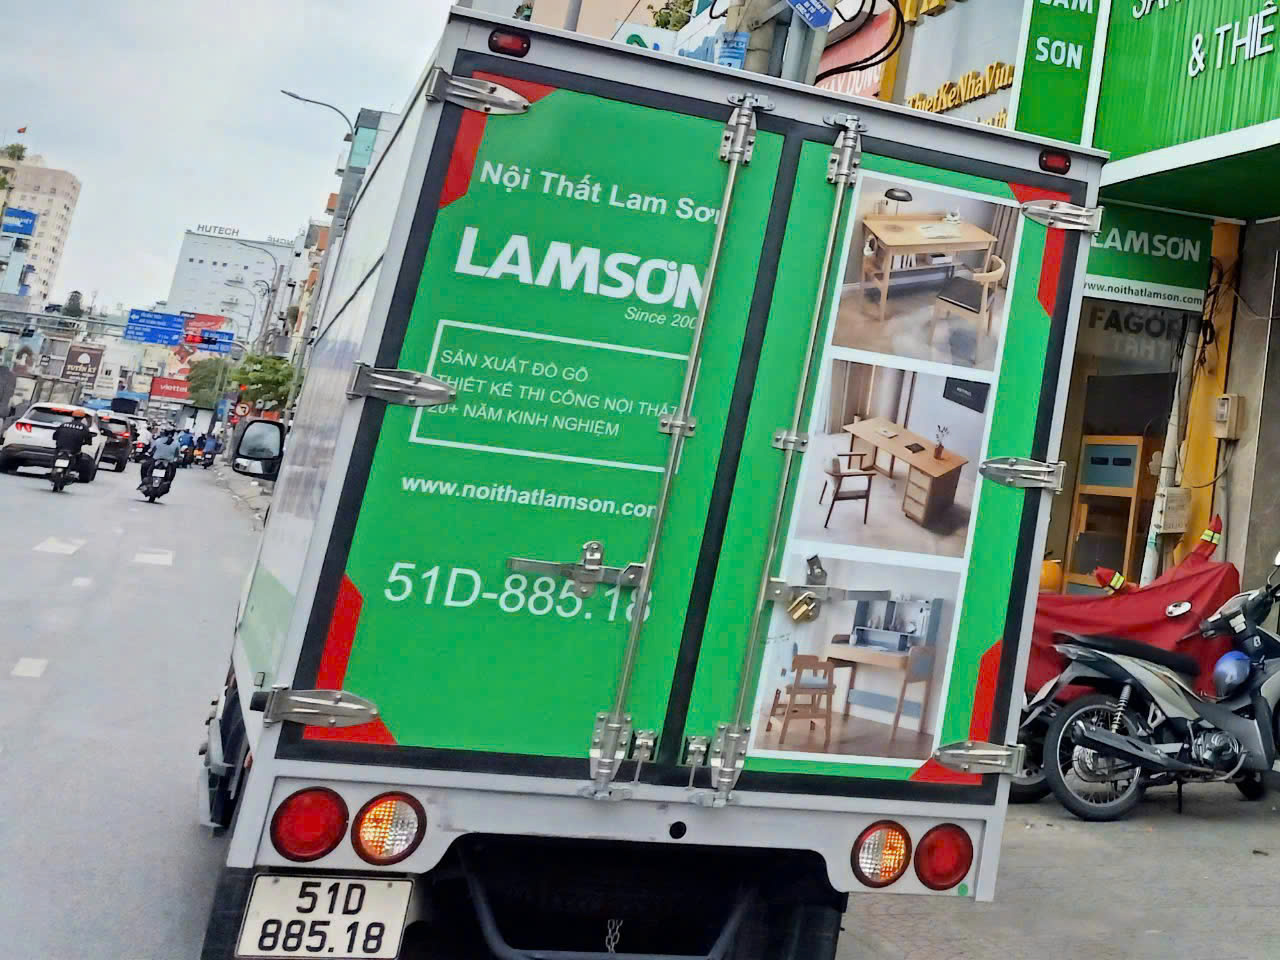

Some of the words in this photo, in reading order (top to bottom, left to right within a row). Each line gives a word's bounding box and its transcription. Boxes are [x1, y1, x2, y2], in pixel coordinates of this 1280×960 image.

[1187, 33, 1206, 77] &
[479, 161, 531, 192] Nội
[540, 170, 602, 203] Thất
[609, 184, 667, 214] Lam
[197, 223, 240, 237] HUTECH
[624, 306, 667, 325] Since
[440, 348, 478, 367] SẢN
[160, 383, 188, 393] viettel
[519, 385, 545, 402] THI
[549, 388, 600, 409] CÔNG
[464, 402, 503, 421] NĂM
[506, 409, 549, 428] KINH
[552, 414, 620, 437] NGHIỆM
[384, 562, 653, 623] 51D-885.18
[296, 881, 367, 916] 51D
[257, 918, 386, 954] 885.18
